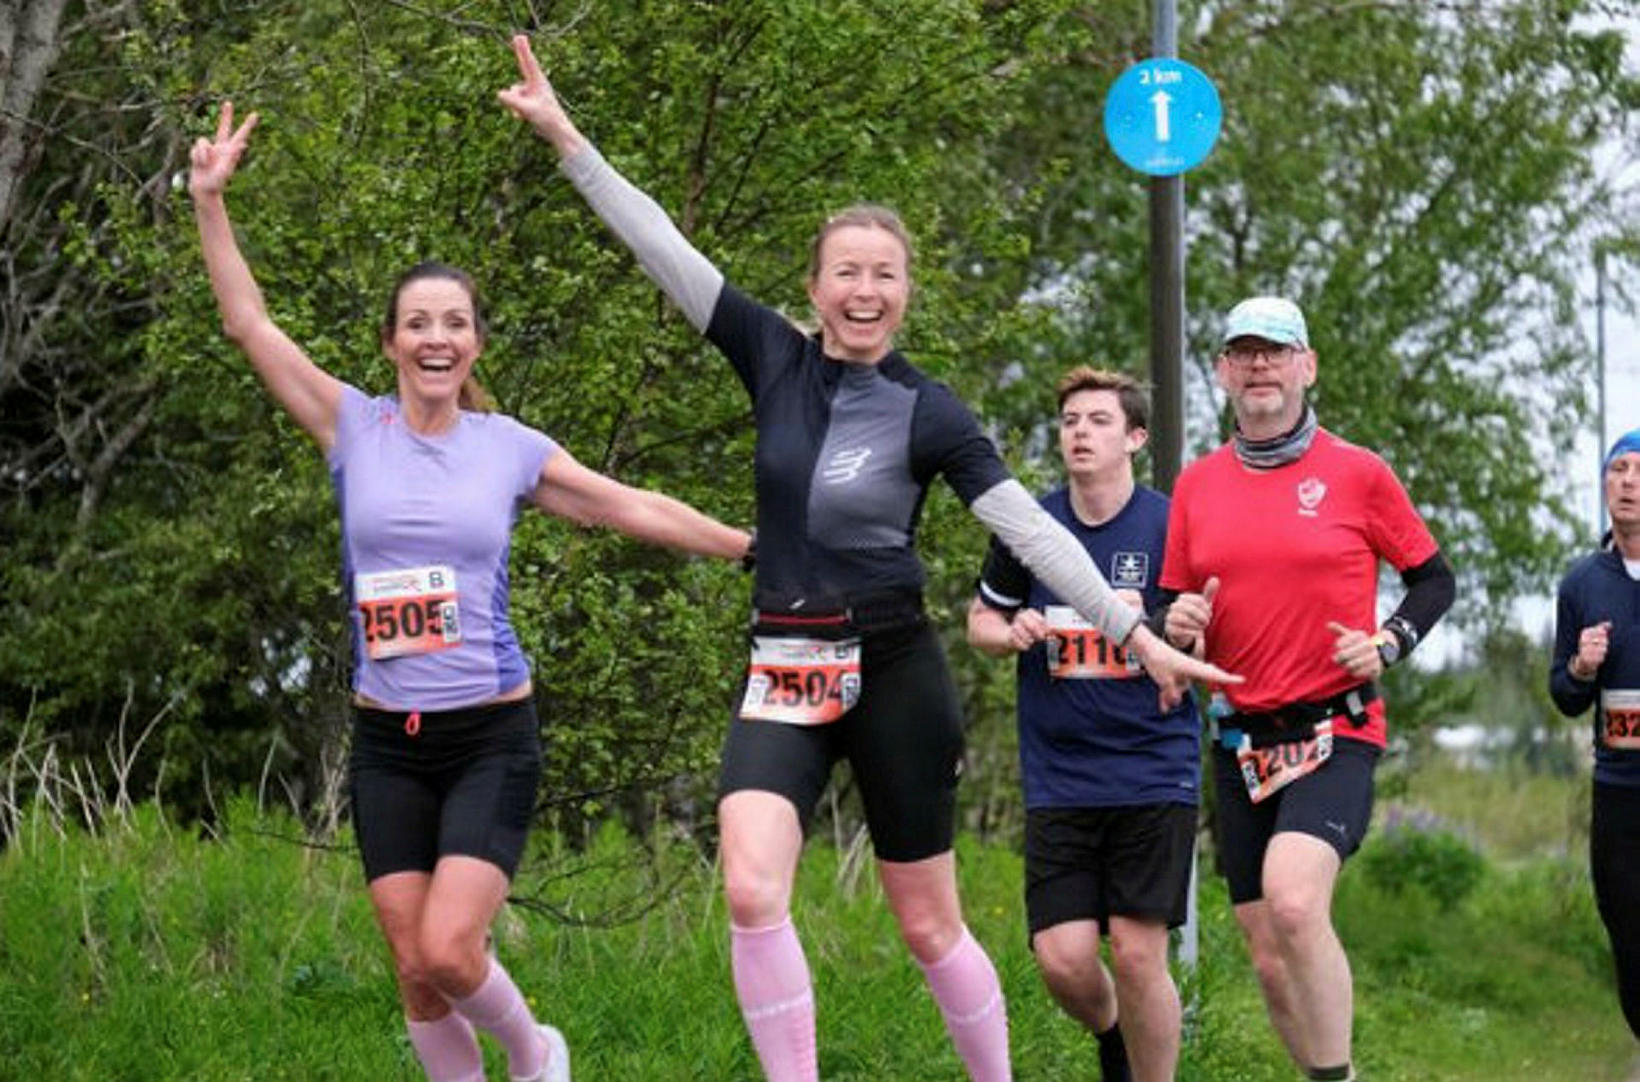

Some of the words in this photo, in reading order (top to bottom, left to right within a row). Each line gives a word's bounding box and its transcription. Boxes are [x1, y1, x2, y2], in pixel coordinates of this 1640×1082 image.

[1153, 67, 1182, 84] km
[429, 572, 444, 588] B
[359, 600, 447, 642] 2505
